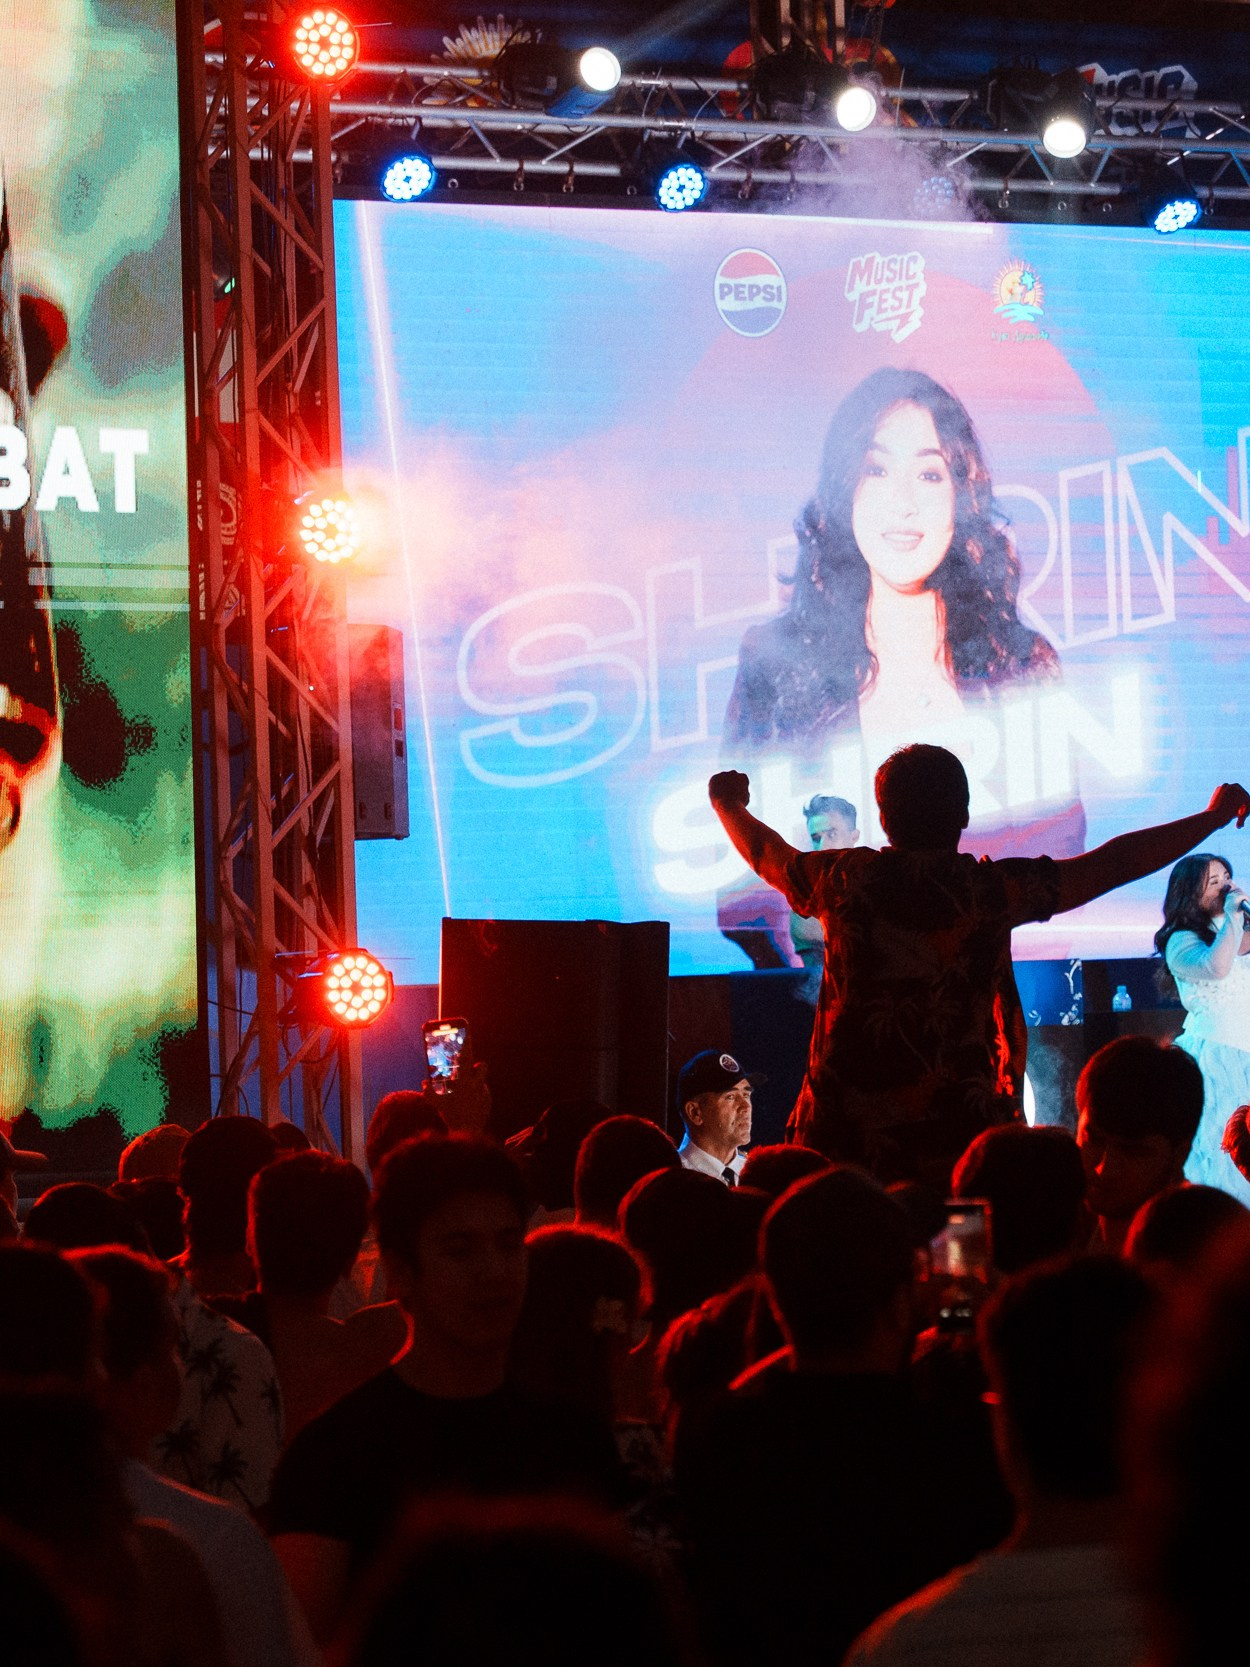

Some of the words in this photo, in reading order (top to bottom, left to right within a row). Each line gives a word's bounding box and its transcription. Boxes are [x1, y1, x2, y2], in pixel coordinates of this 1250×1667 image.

[1080, 66, 1190, 128] USIC
[850, 253, 919, 288] MUSIC
[718, 282, 784, 303] PEPSI
[854, 282, 917, 326] FEST
